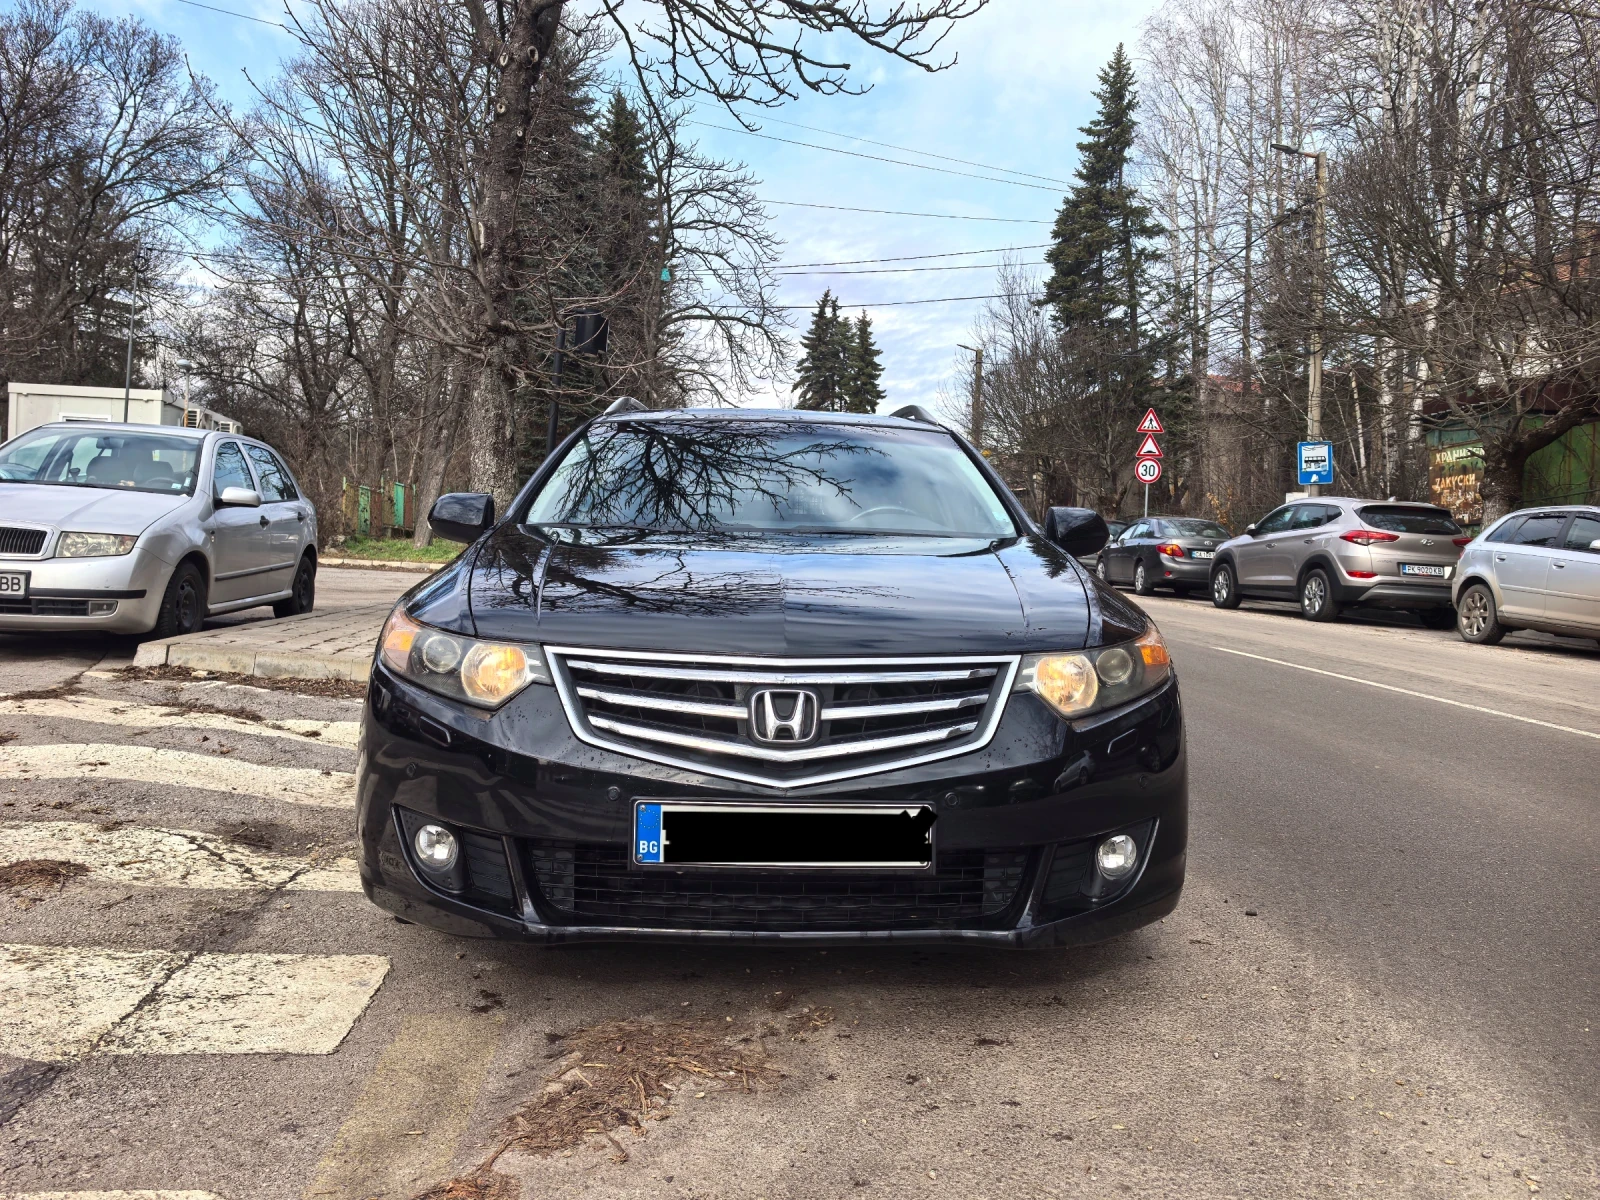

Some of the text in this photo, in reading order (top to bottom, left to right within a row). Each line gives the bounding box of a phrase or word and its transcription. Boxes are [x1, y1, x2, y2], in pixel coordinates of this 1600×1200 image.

[1141, 464, 1156, 477] 30
[1417, 566, 1433, 574] 9020
[1434, 567, 1443, 575] KB
[639, 841, 658, 854] BG
